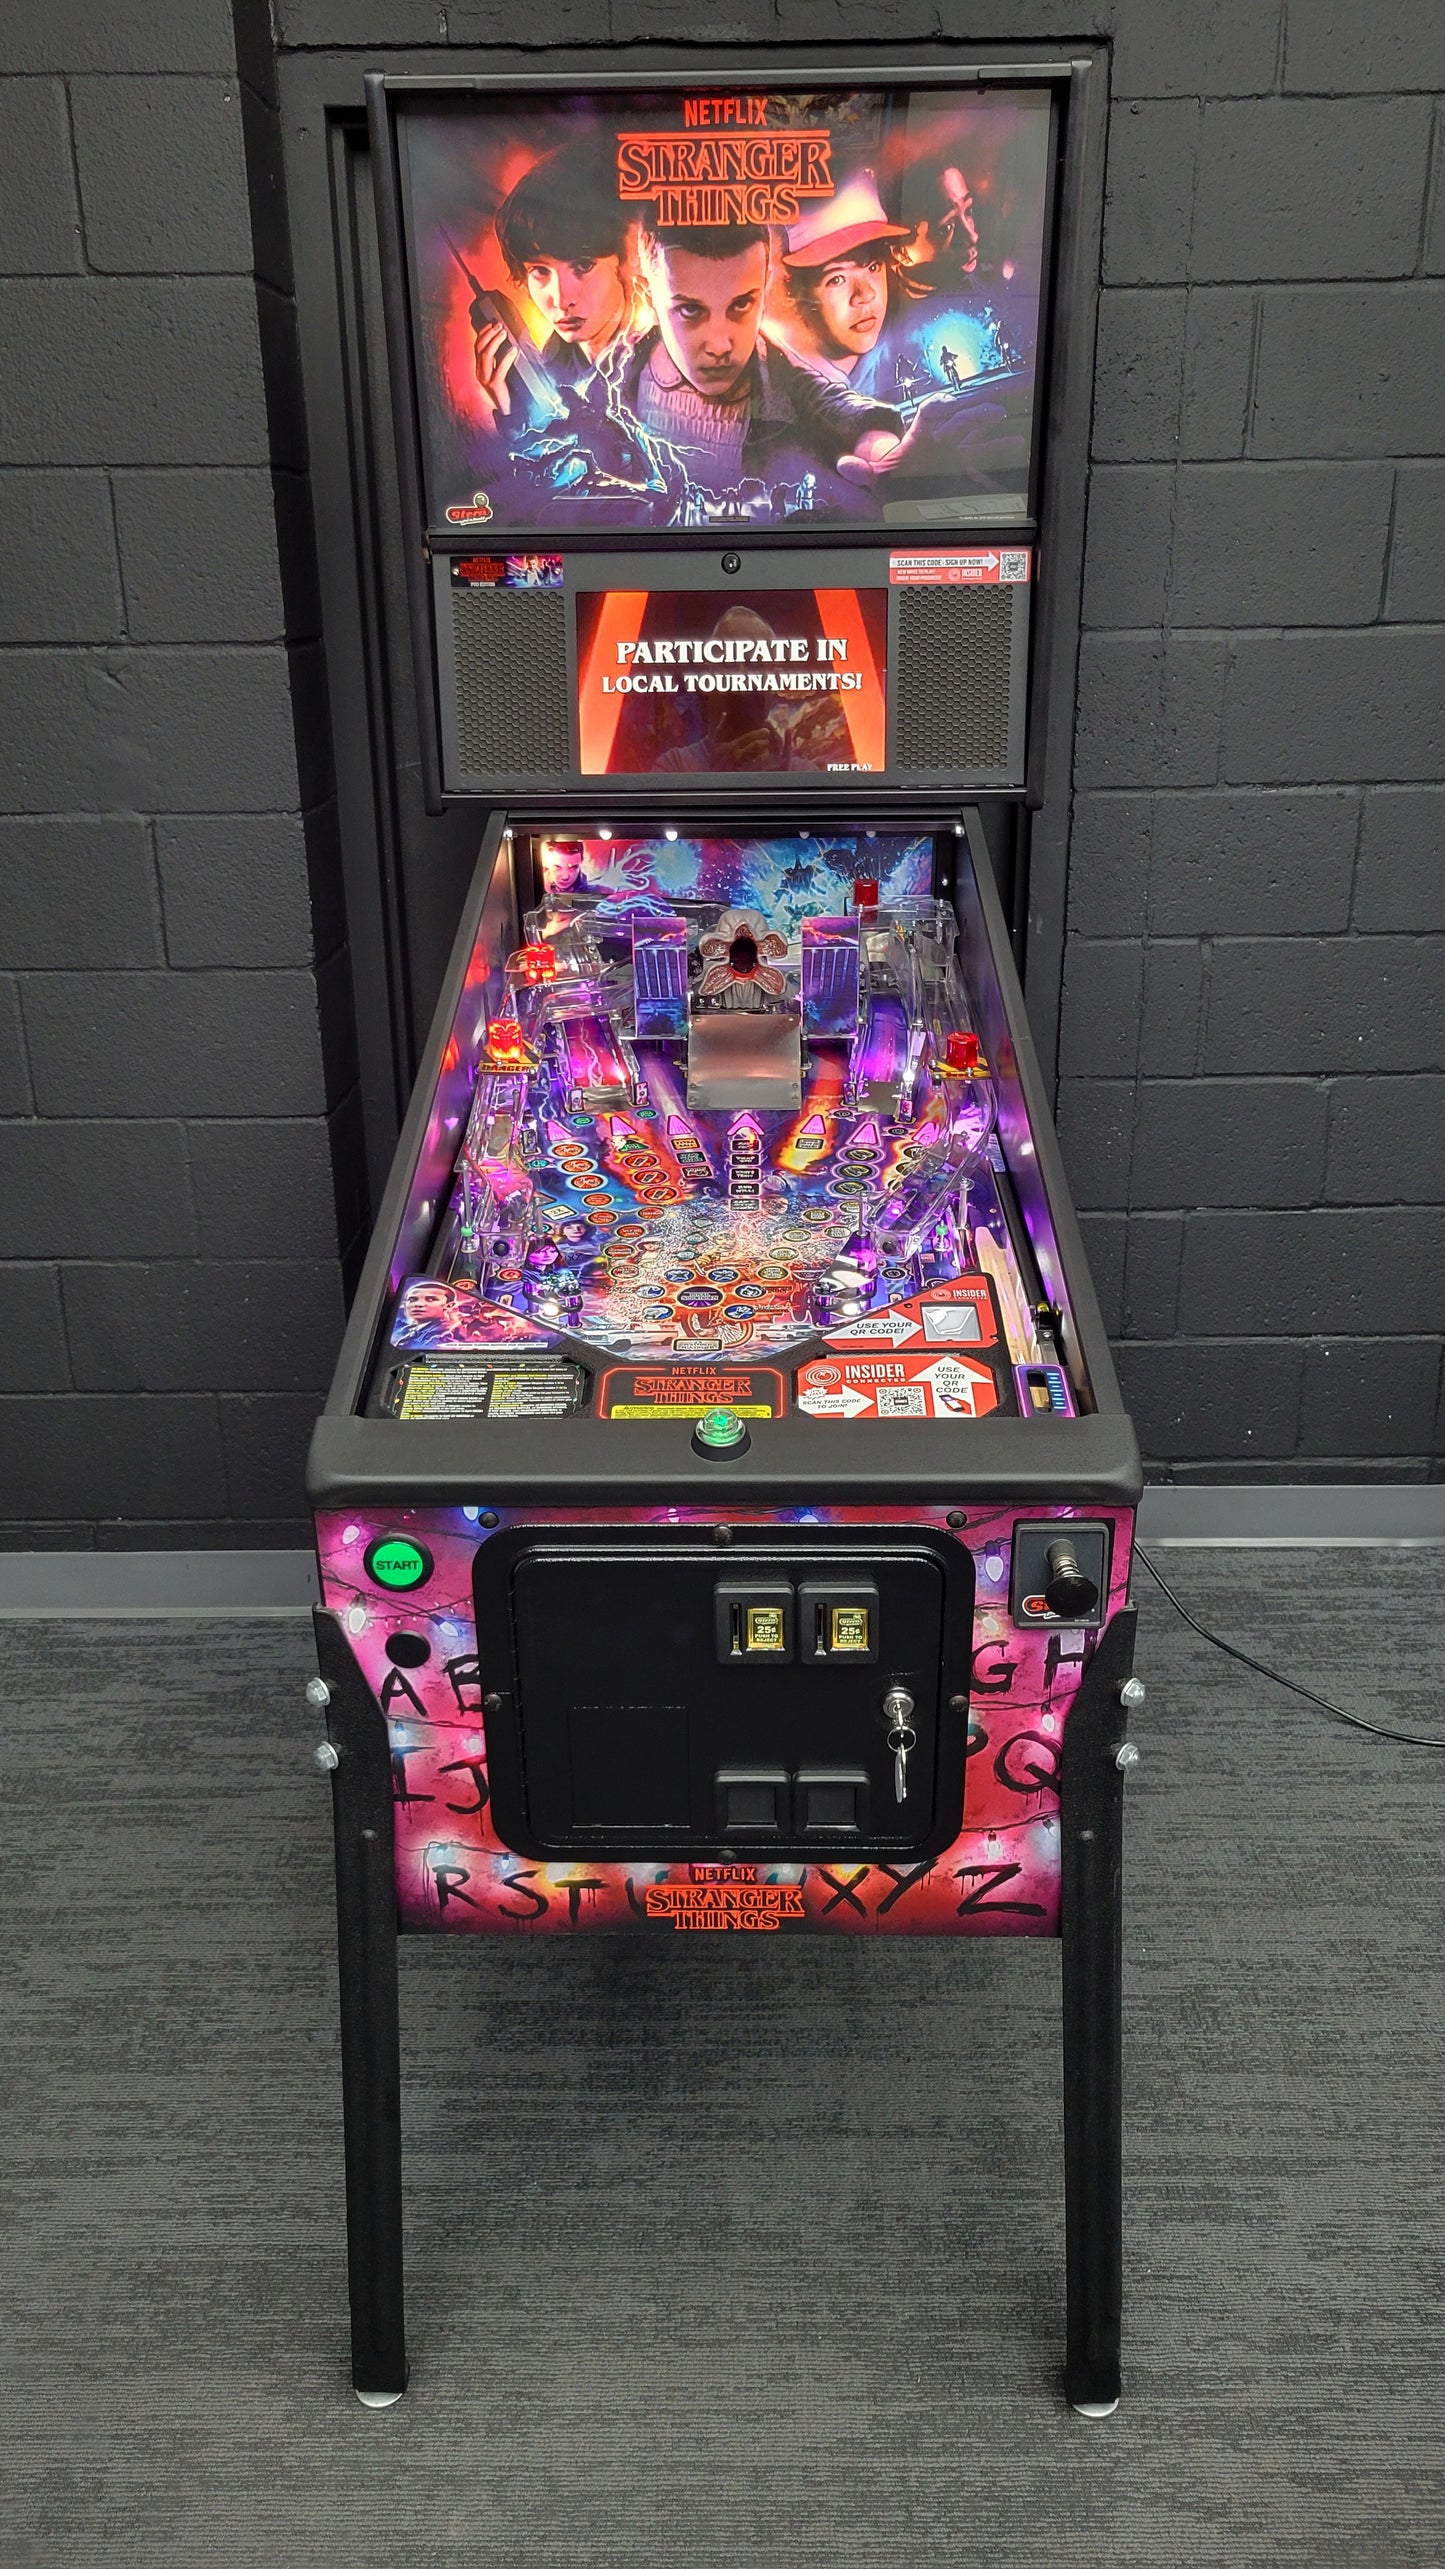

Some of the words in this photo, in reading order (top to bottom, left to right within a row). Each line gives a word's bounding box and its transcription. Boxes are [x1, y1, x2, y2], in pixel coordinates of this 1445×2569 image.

[684, 98, 768, 127] NETFLIX
[617, 139, 835, 192] STRANGER
[652, 184, 800, 226] THINGS
[616, 638, 810, 664] PARTICIPATE
[816, 638, 848, 662] IN
[601, 674, 680, 693] LOCAL
[684, 673, 863, 693] TOURNAMENTS!
[827, 763, 850, 771] FREE
[851, 763, 873, 771] PLAY
[952, 1289, 987, 1298] INSIDER
[882, 1321, 913, 1329] YOUR
[671, 1367, 717, 1376] NETFLIX
[845, 1363, 906, 1379] INSIDER
[934, 1372, 966, 1380] YOUR
[634, 1379, 753, 1394] STRANGER
[942, 1379, 959, 1387] QR
[935, 1386, 969, 1394] CODE
[653, 1392, 734, 1404] THINGS
[376, 1560, 420, 1571] START
[757, 1626, 776, 1634] 25¢
[695, 1868, 756, 1882] NETFLIX
[646, 1887, 805, 1915] STRANGER
[673, 1911, 780, 1930] THINGS
